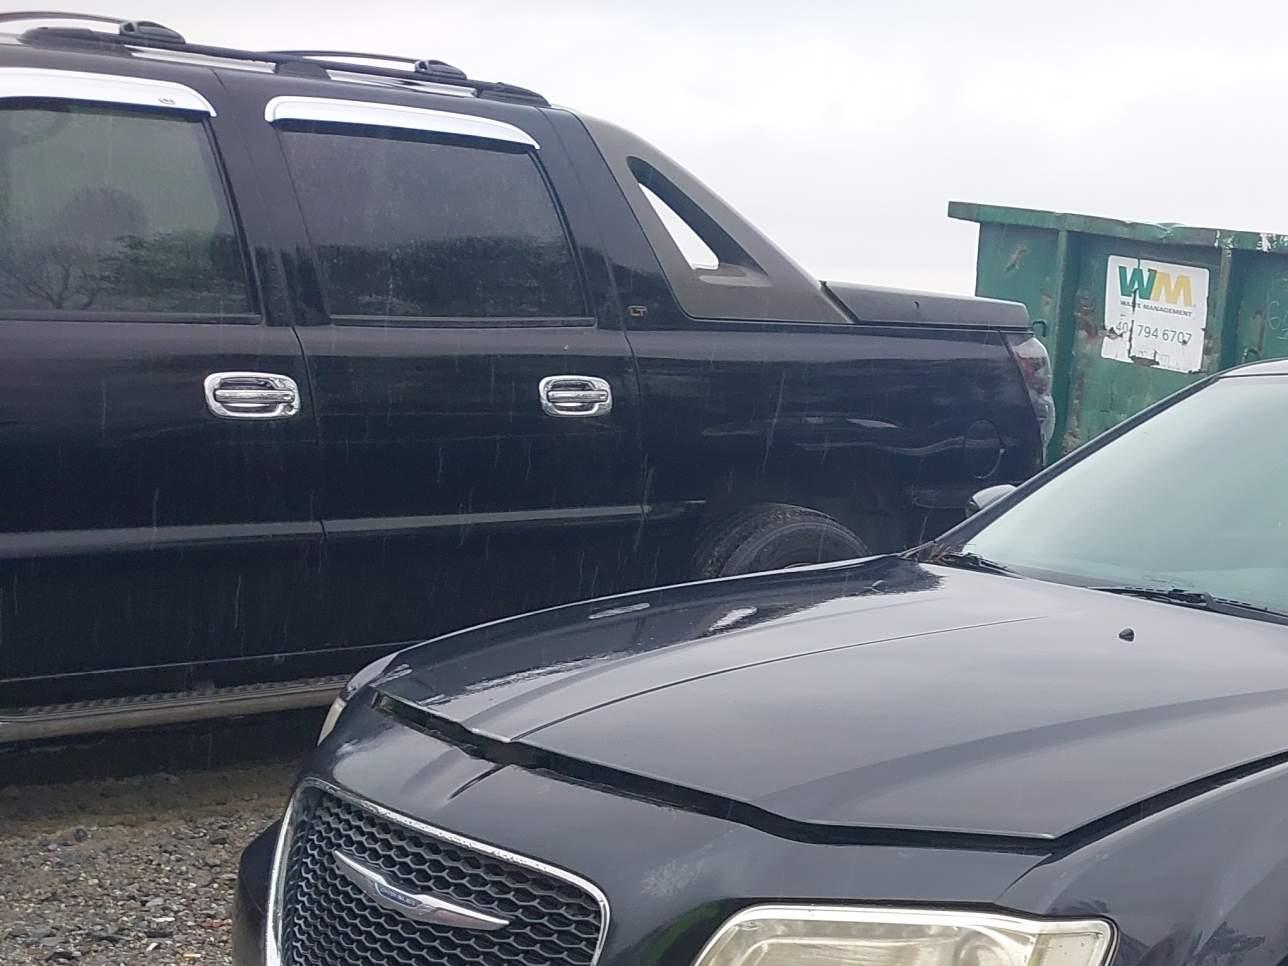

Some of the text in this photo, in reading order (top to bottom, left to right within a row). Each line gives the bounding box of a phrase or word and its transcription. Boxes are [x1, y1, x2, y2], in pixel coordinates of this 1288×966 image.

[1118, 265, 1192, 307] WM
[1119, 300, 1192, 317] WAE MANAGEMENT
[1136, 324, 1158, 338] 794
[1162, 328, 1192, 345] 6707
